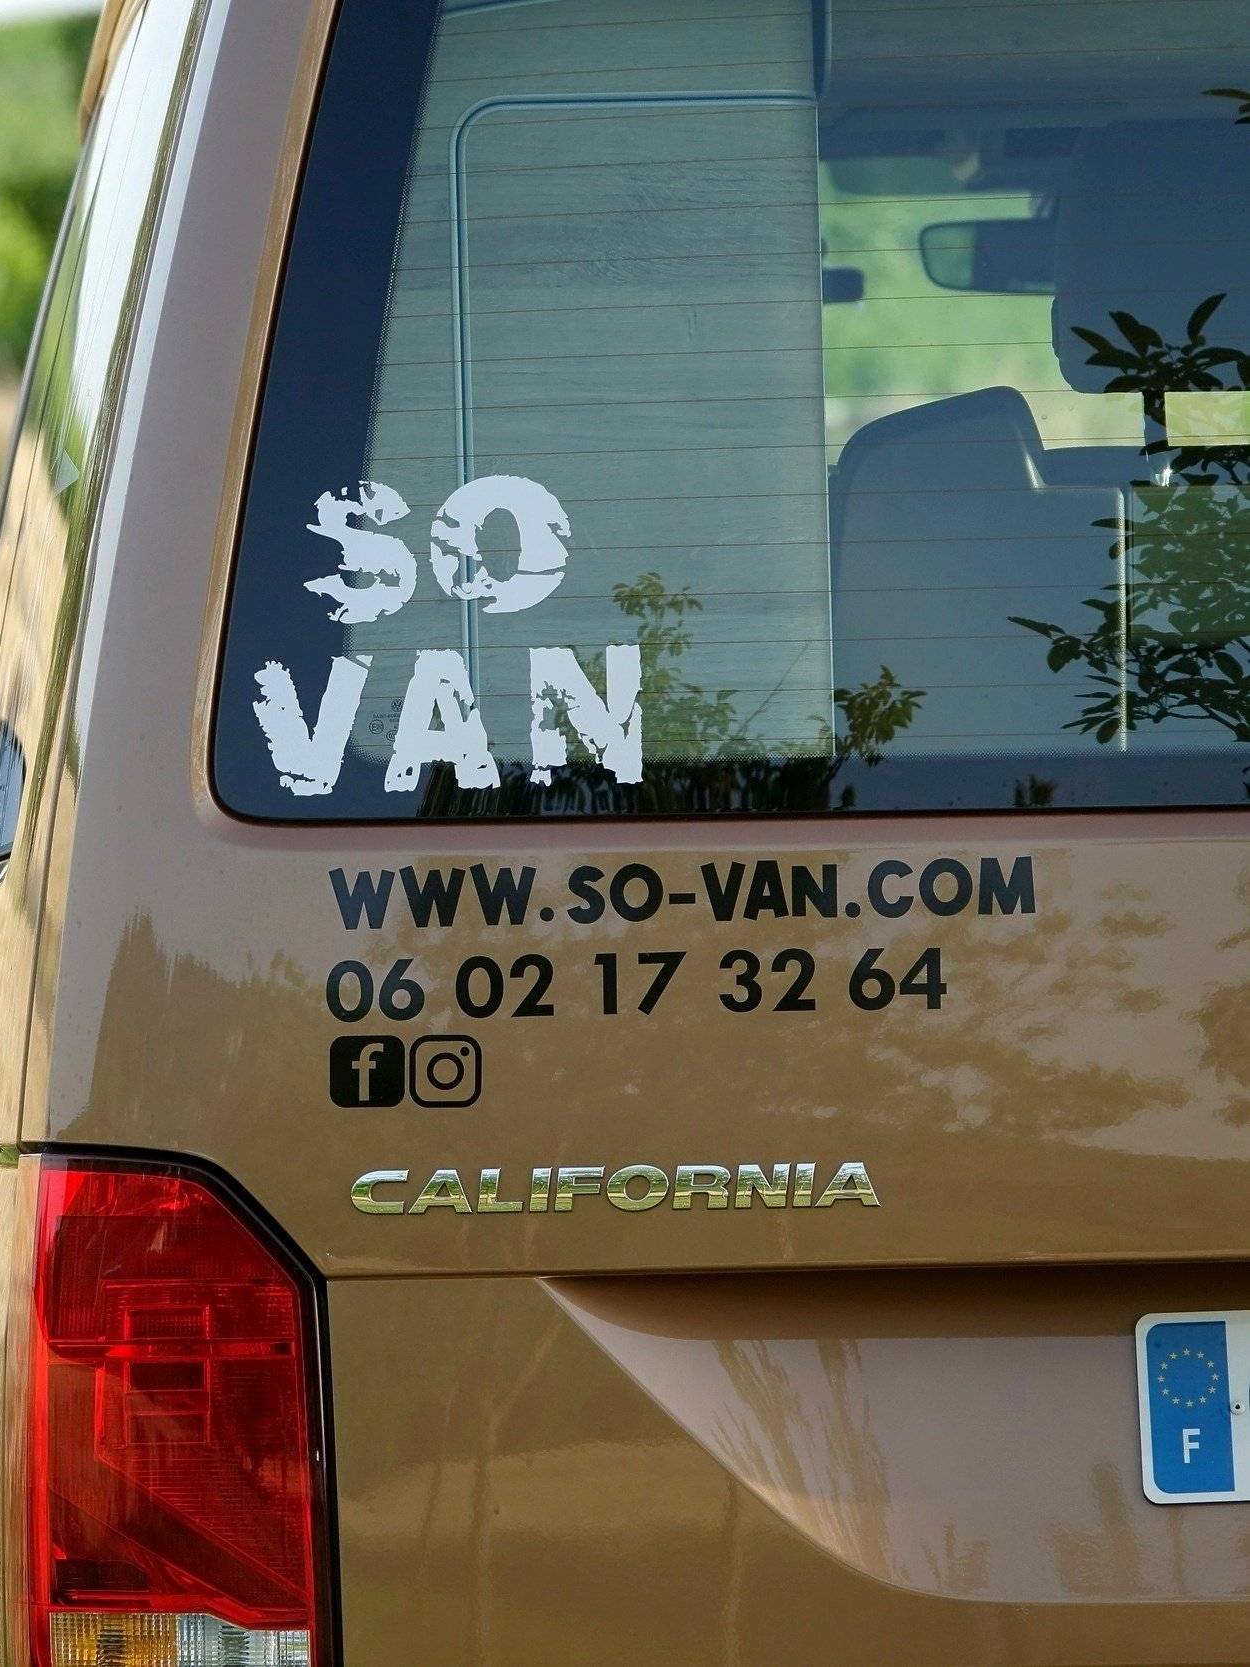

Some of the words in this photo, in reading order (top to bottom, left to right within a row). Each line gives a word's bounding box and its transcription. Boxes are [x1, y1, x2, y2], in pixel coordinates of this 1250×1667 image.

[303, 474, 572, 624] SO
[252, 643, 643, 797] VAN
[328, 855, 1037, 930] WWW.SO-VAN.COM
[326, 959, 426, 1022] 06
[455, 954, 554, 1019] 02
[595, 951, 686, 1015] 17
[719, 948, 816, 1013] 32
[848, 947, 948, 1011] 64
[351, 1161, 882, 1215] CALIFORNIA
[1182, 1428, 1201, 1464] F
